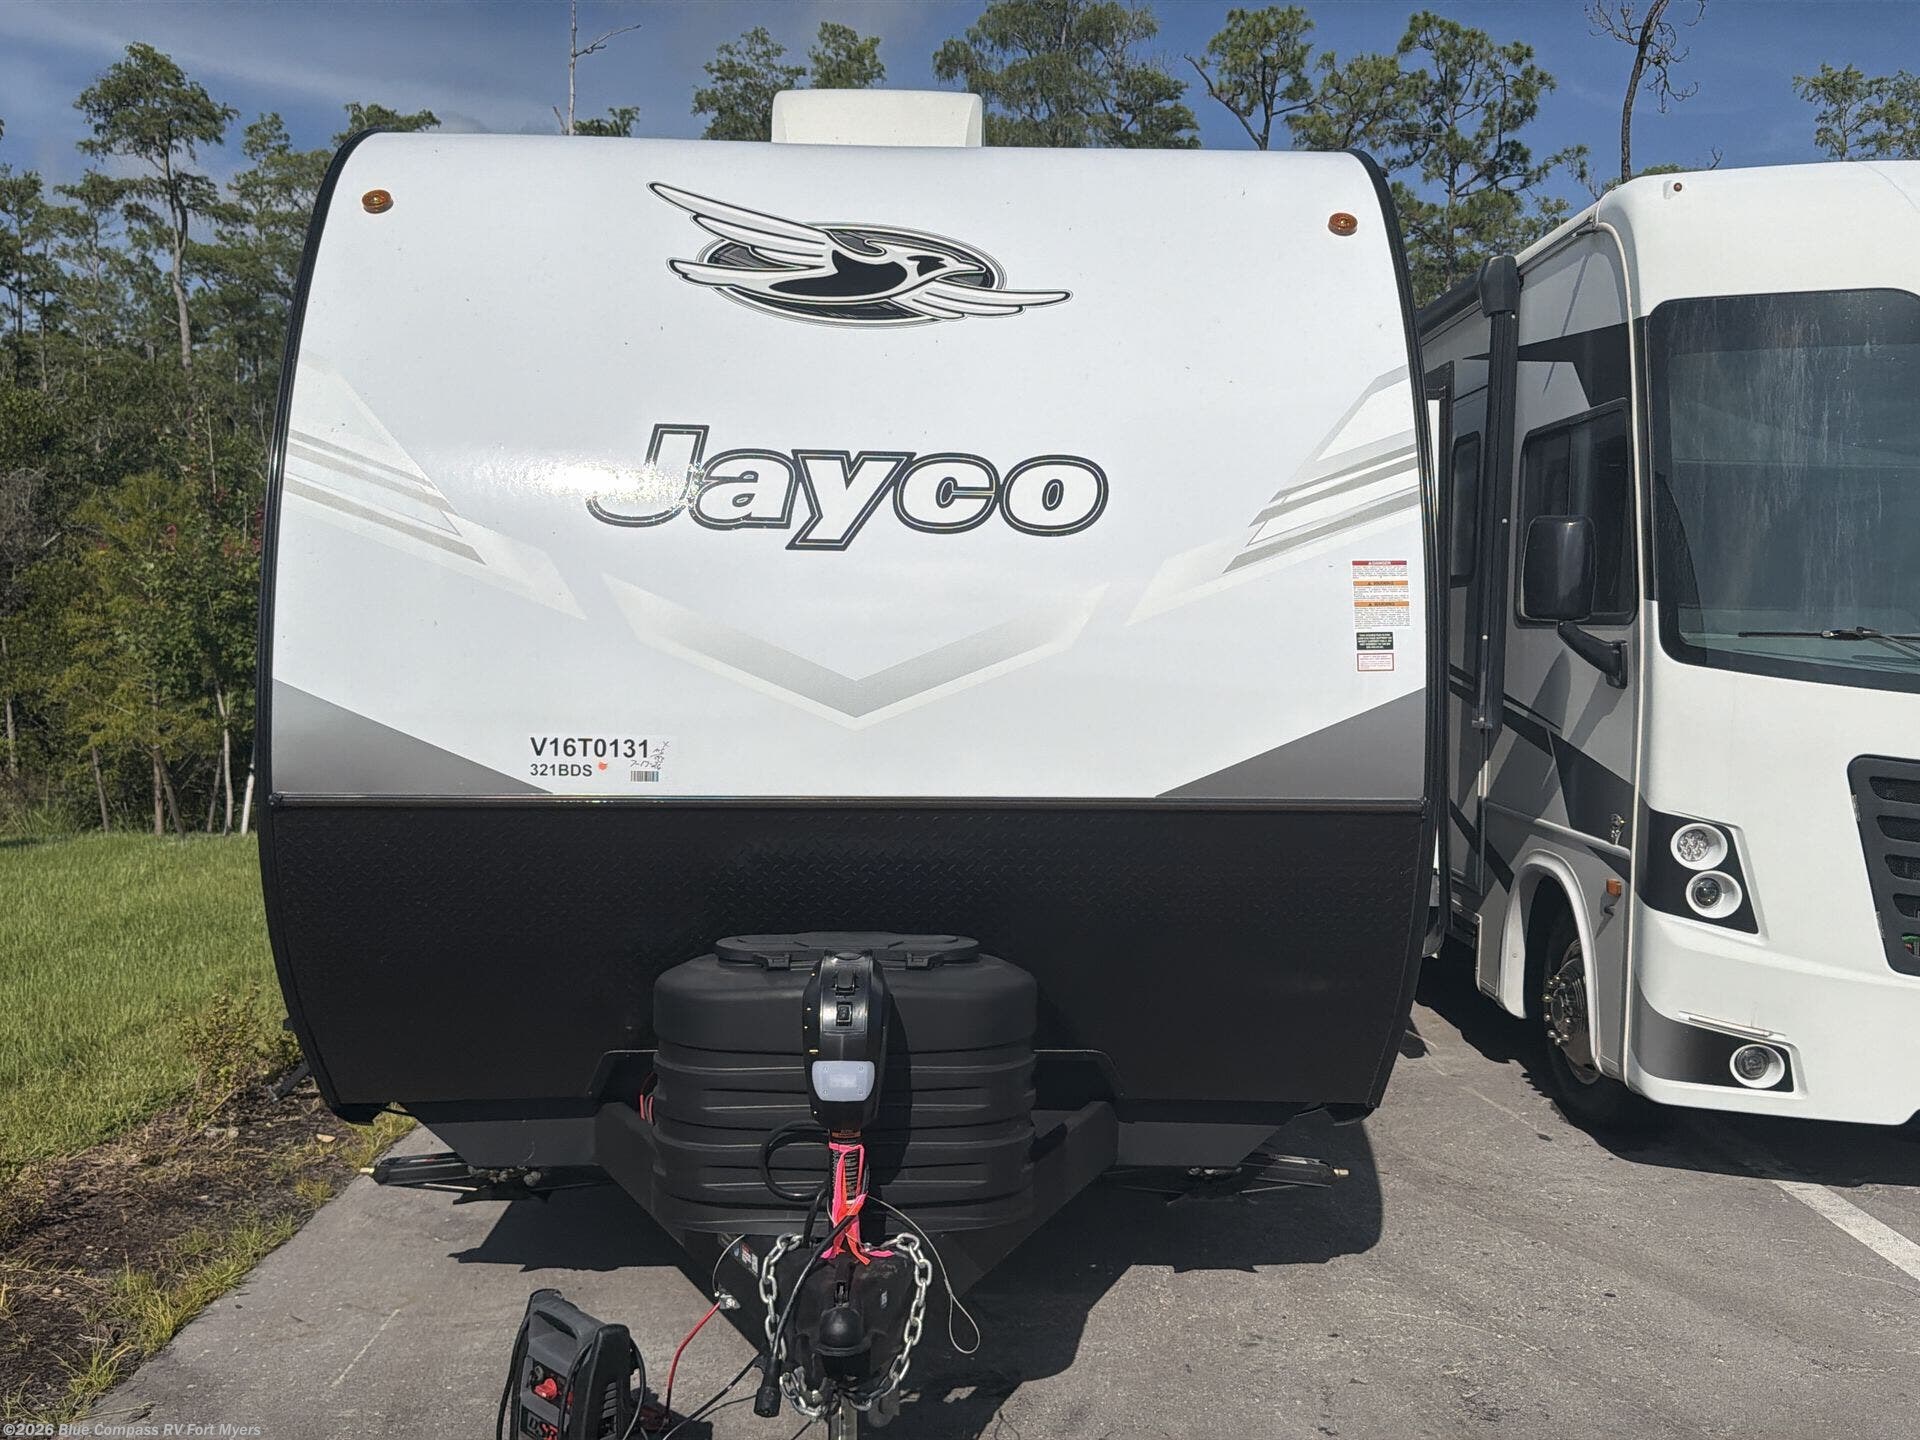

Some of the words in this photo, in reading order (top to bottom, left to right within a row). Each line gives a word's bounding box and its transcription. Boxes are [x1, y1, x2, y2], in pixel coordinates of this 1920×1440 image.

[584, 424, 1109, 551] Jayco
[530, 737, 648, 758] V16T0131
[530, 763, 593, 777] 321BDS
